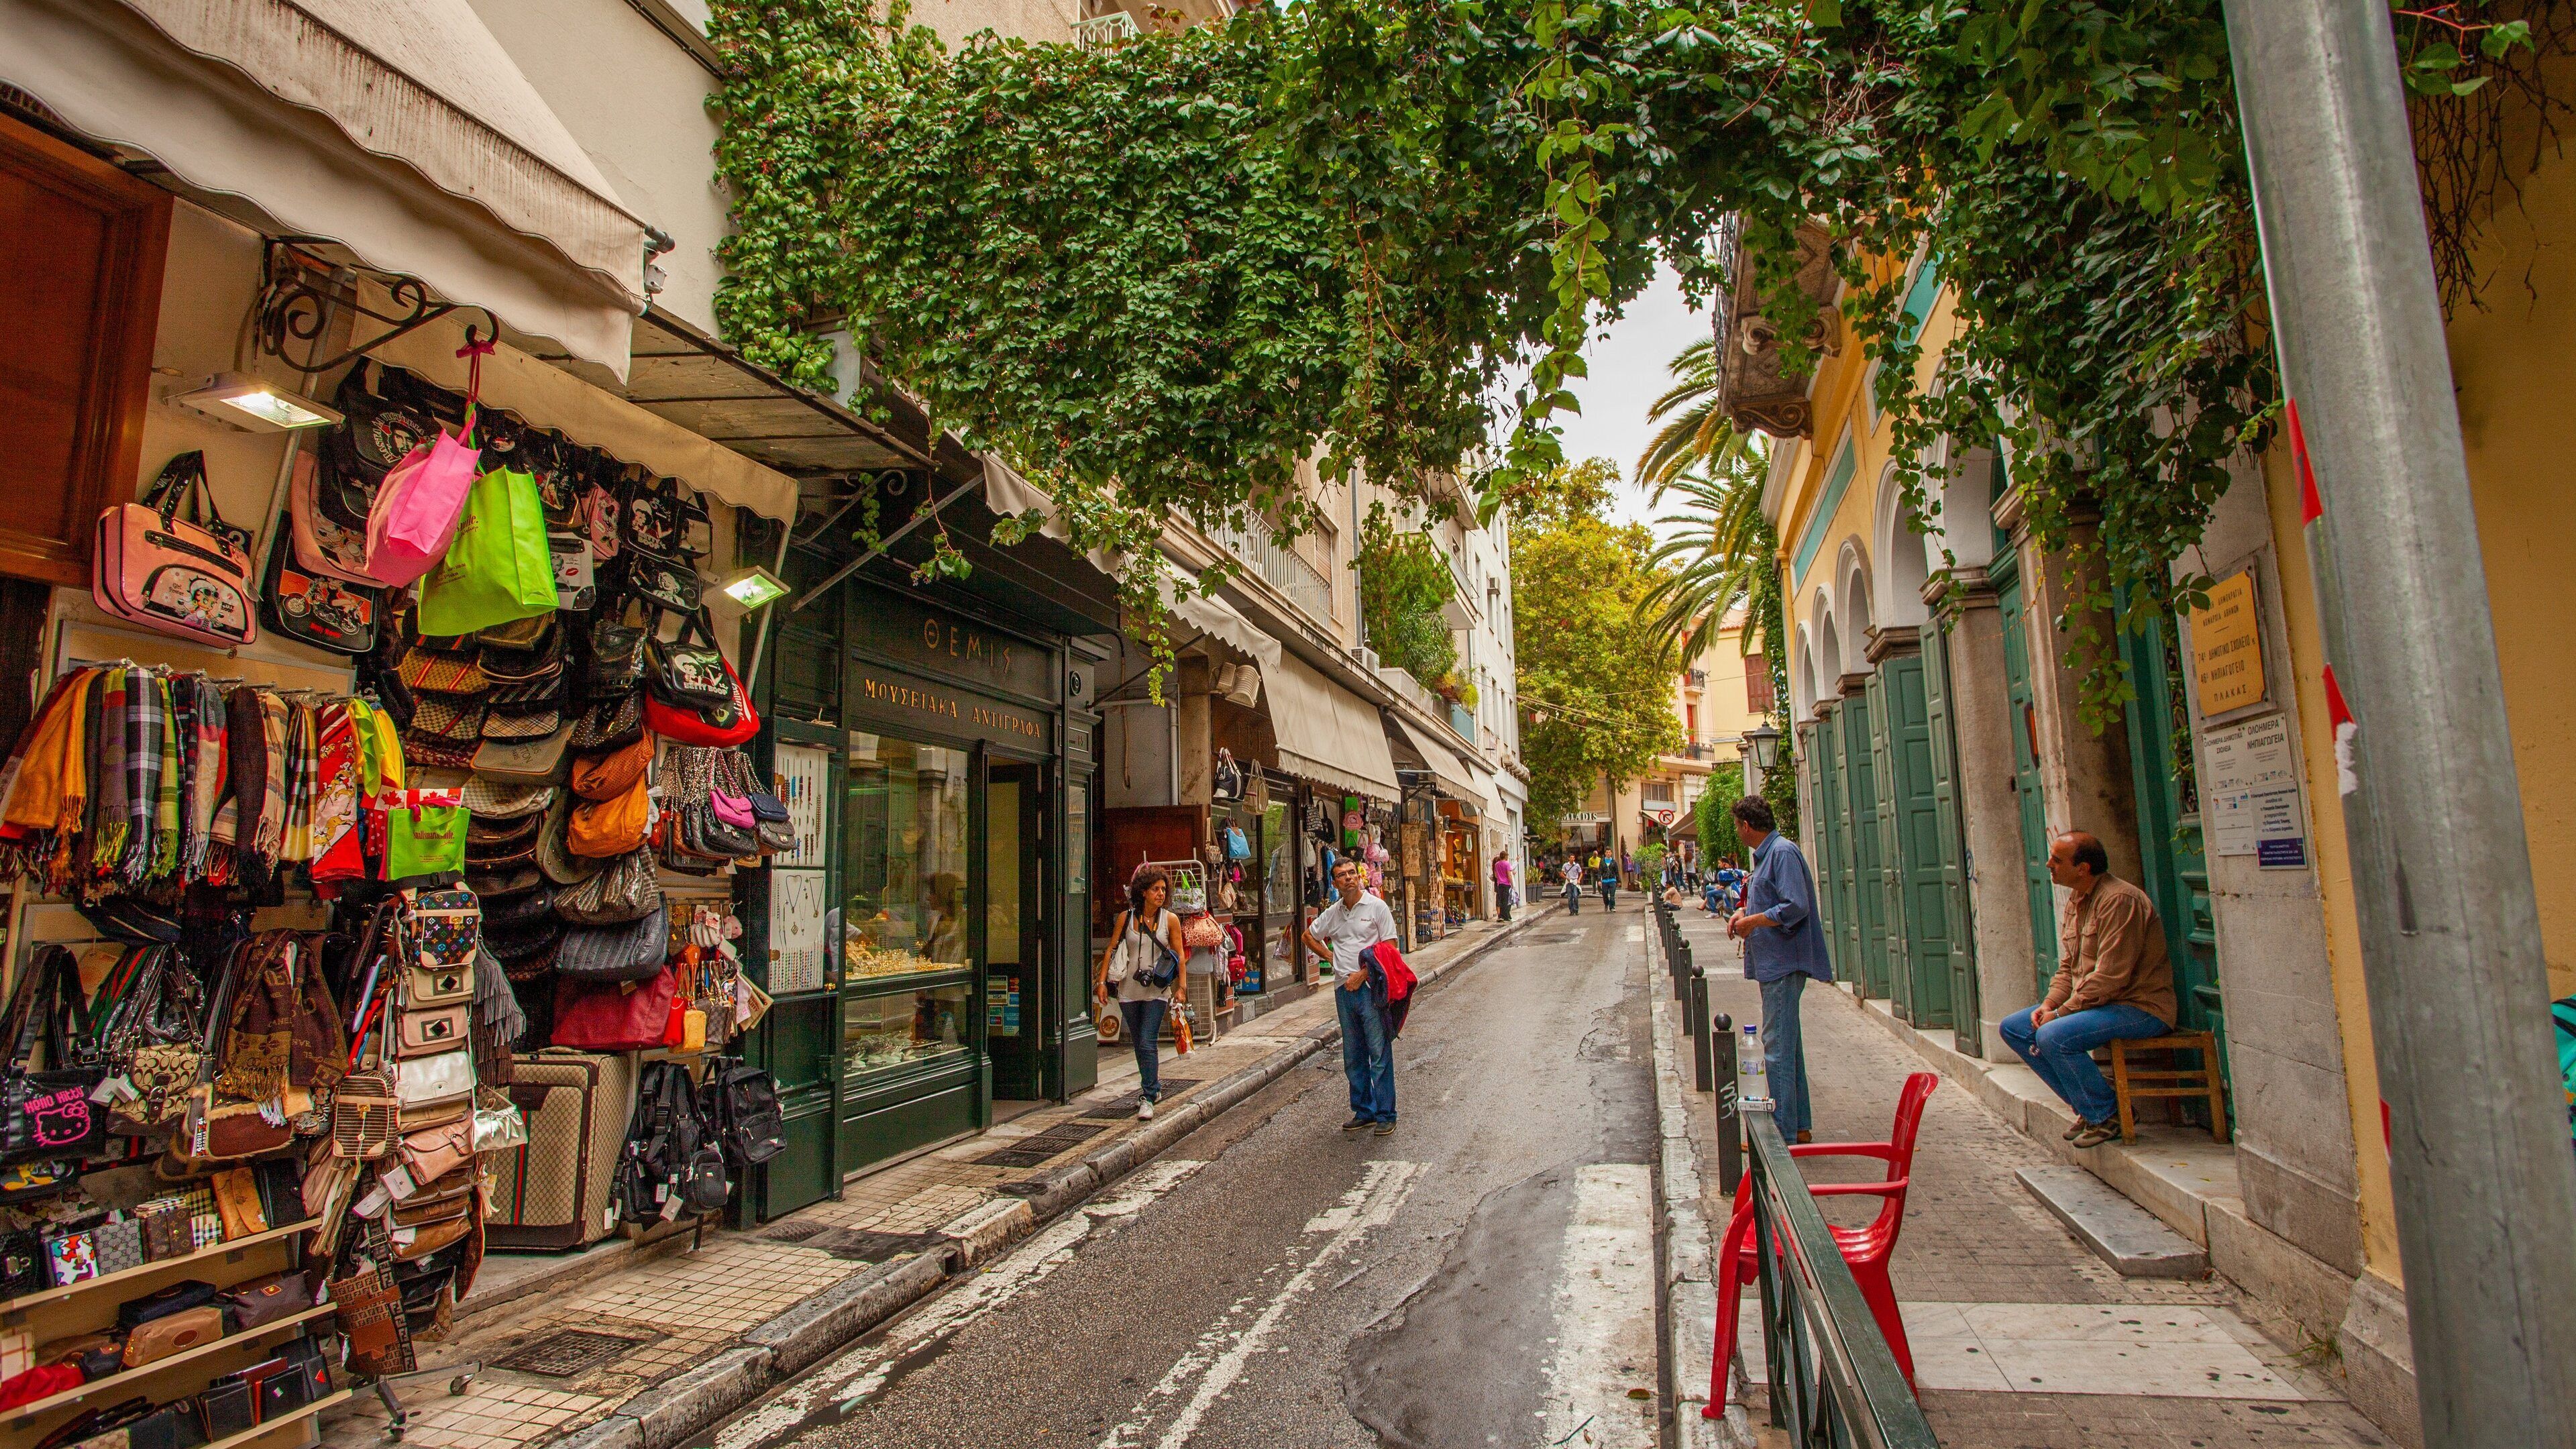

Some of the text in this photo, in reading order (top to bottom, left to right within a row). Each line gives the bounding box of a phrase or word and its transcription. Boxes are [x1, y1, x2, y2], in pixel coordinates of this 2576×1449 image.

[2209, 643, 2229, 660] ΔΗΜΟΤΙΚΟ
[2231, 634, 2250, 651] ΣΧΟΛΕΙΟ
[2214, 684, 2247, 702] ΠΛΑΚΑΣ
[865, 678, 1040, 739] ΜΟΥΣΕΙΑΚΑ ΑΝΤΙΓΡΑΦΑ
[2247, 719, 2279, 735] ΟΛΟΗΜΕΡΑ
[2247, 733, 2284, 750] ΝΗΠΙΑΓΩΓΕΙΑ
